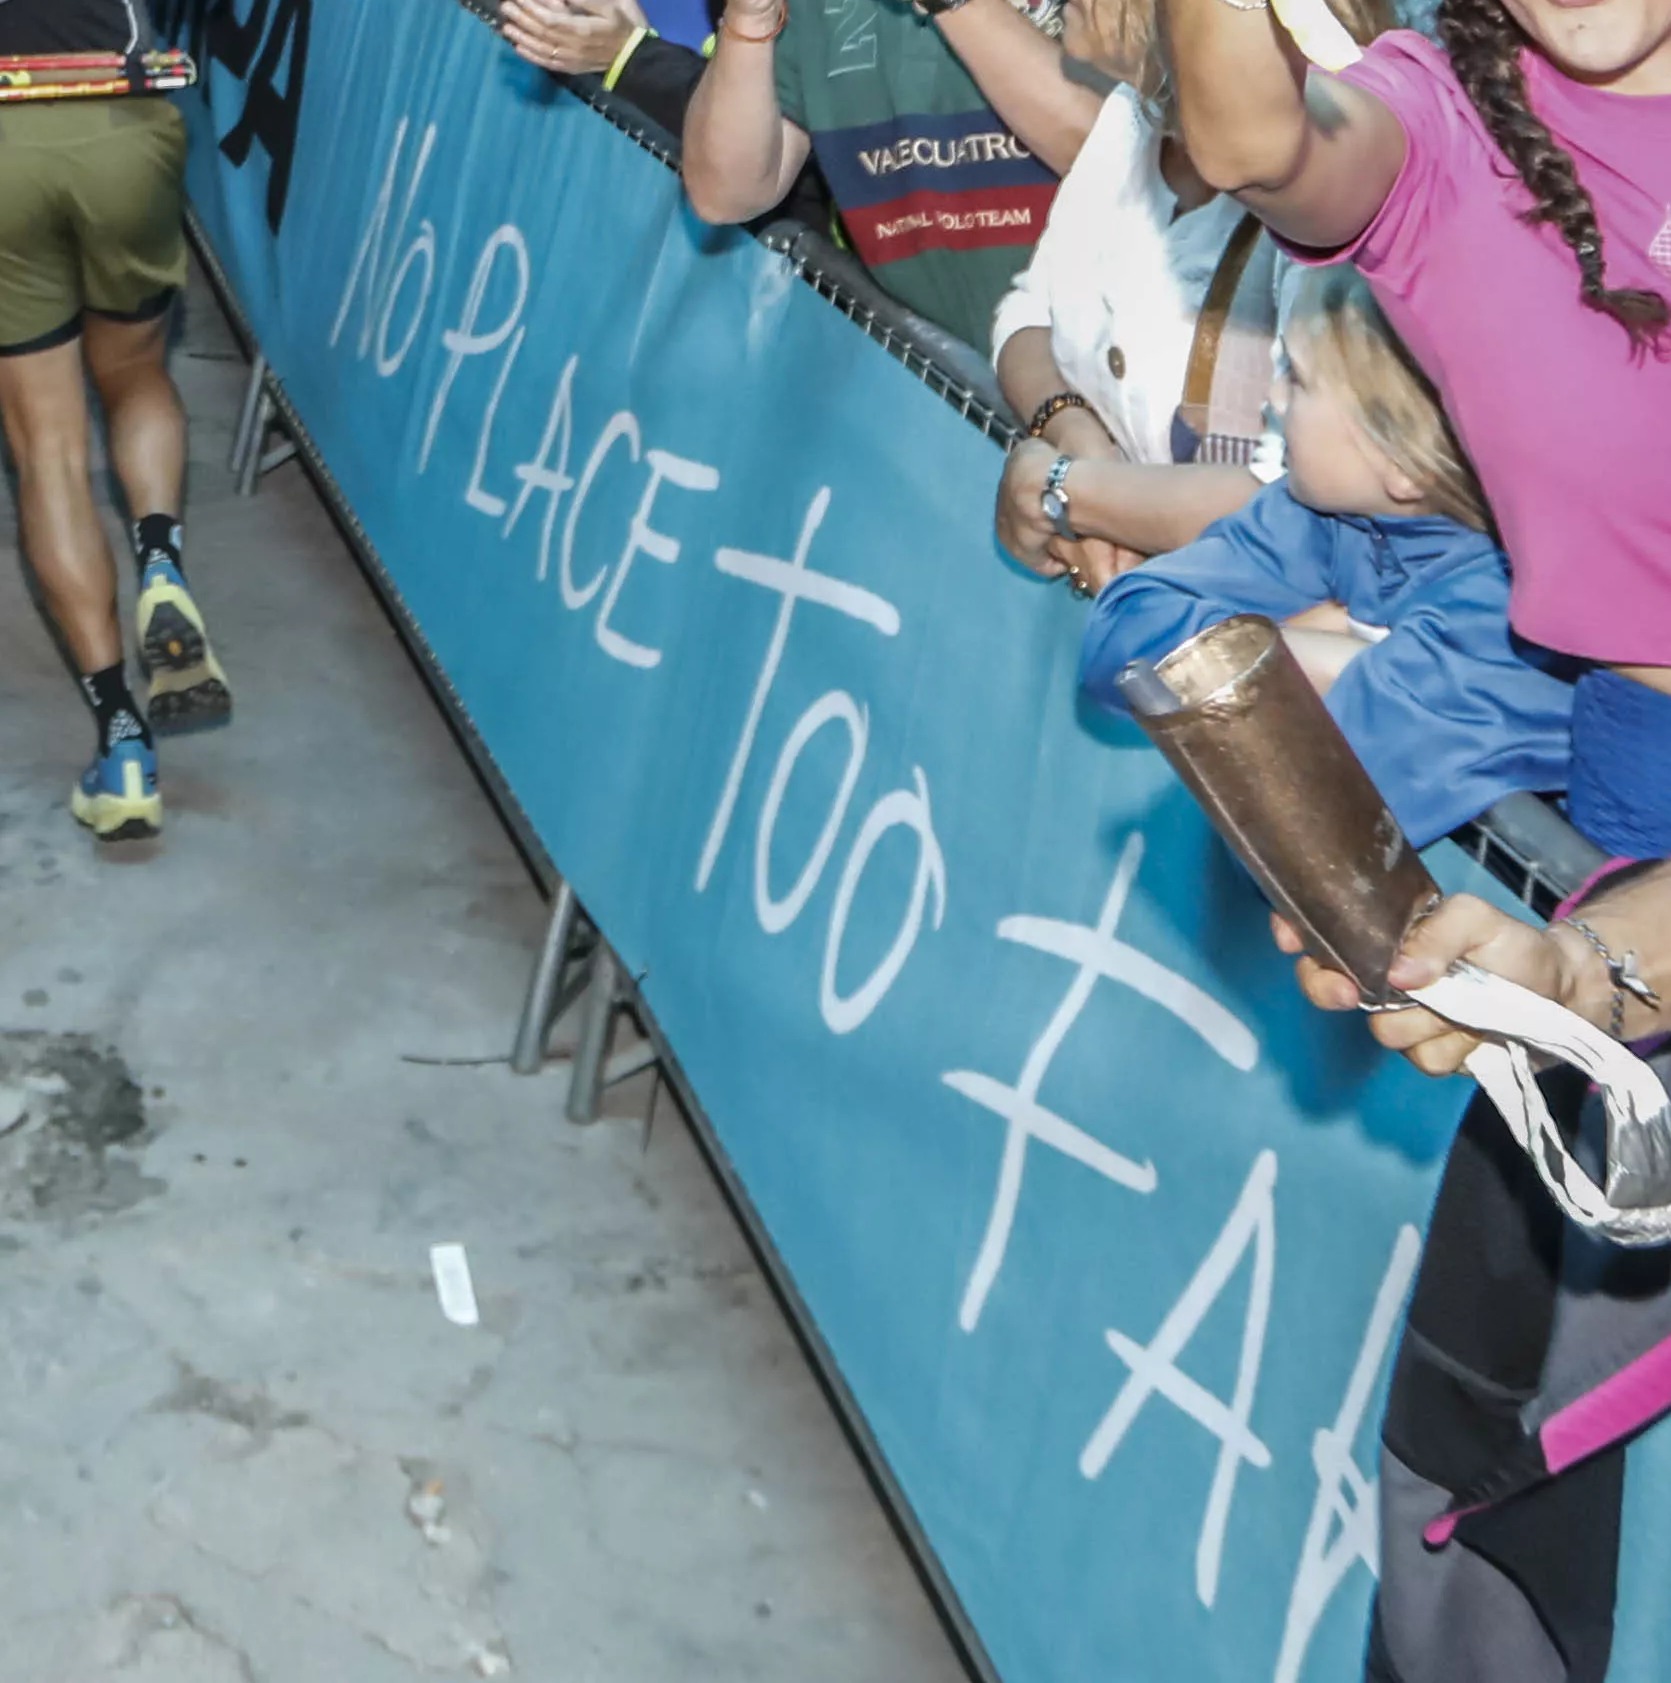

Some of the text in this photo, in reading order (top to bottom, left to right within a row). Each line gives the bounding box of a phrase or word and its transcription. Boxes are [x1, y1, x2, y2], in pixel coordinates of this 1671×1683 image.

[975, 207, 1032, 228] TEAM
[329, 116, 436, 378] NO
[418, 223, 720, 669] PLACE
[694, 484, 946, 1033] TOO
